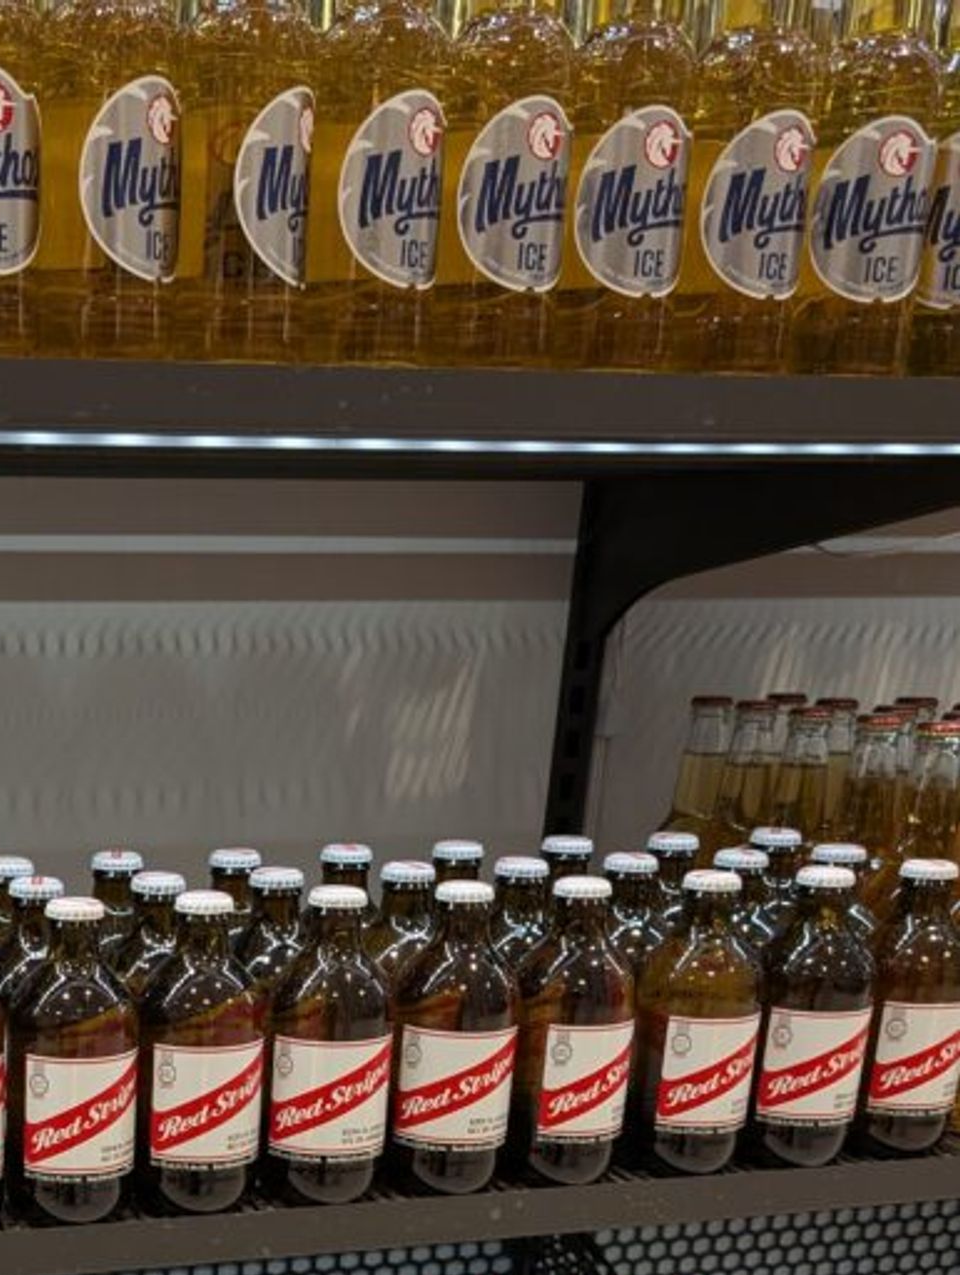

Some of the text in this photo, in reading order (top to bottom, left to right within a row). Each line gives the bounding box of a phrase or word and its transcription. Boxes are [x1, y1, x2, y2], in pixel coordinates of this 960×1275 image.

[101, 137, 180, 226] Myth
[359, 150, 439, 235] Myth
[475, 155, 565, 239] Myth
[718, 168, 805, 248] Myth
[400, 240, 429, 269] ICE
[517, 242, 548, 272] ICE
[633, 249, 664, 279] ICE
[758, 252, 787, 281] ICE
[864, 256, 899, 284] ICE
[666, 1072, 721, 1107] Red
[767, 1065, 822, 1098] Red
[880, 1056, 934, 1090] Red
[275, 1093, 325, 1131] Red
[401, 1088, 451, 1119] Red
[547, 1080, 601, 1119] Red
[31, 1116, 81, 1154] Red
[158, 1103, 211, 1142] Red
